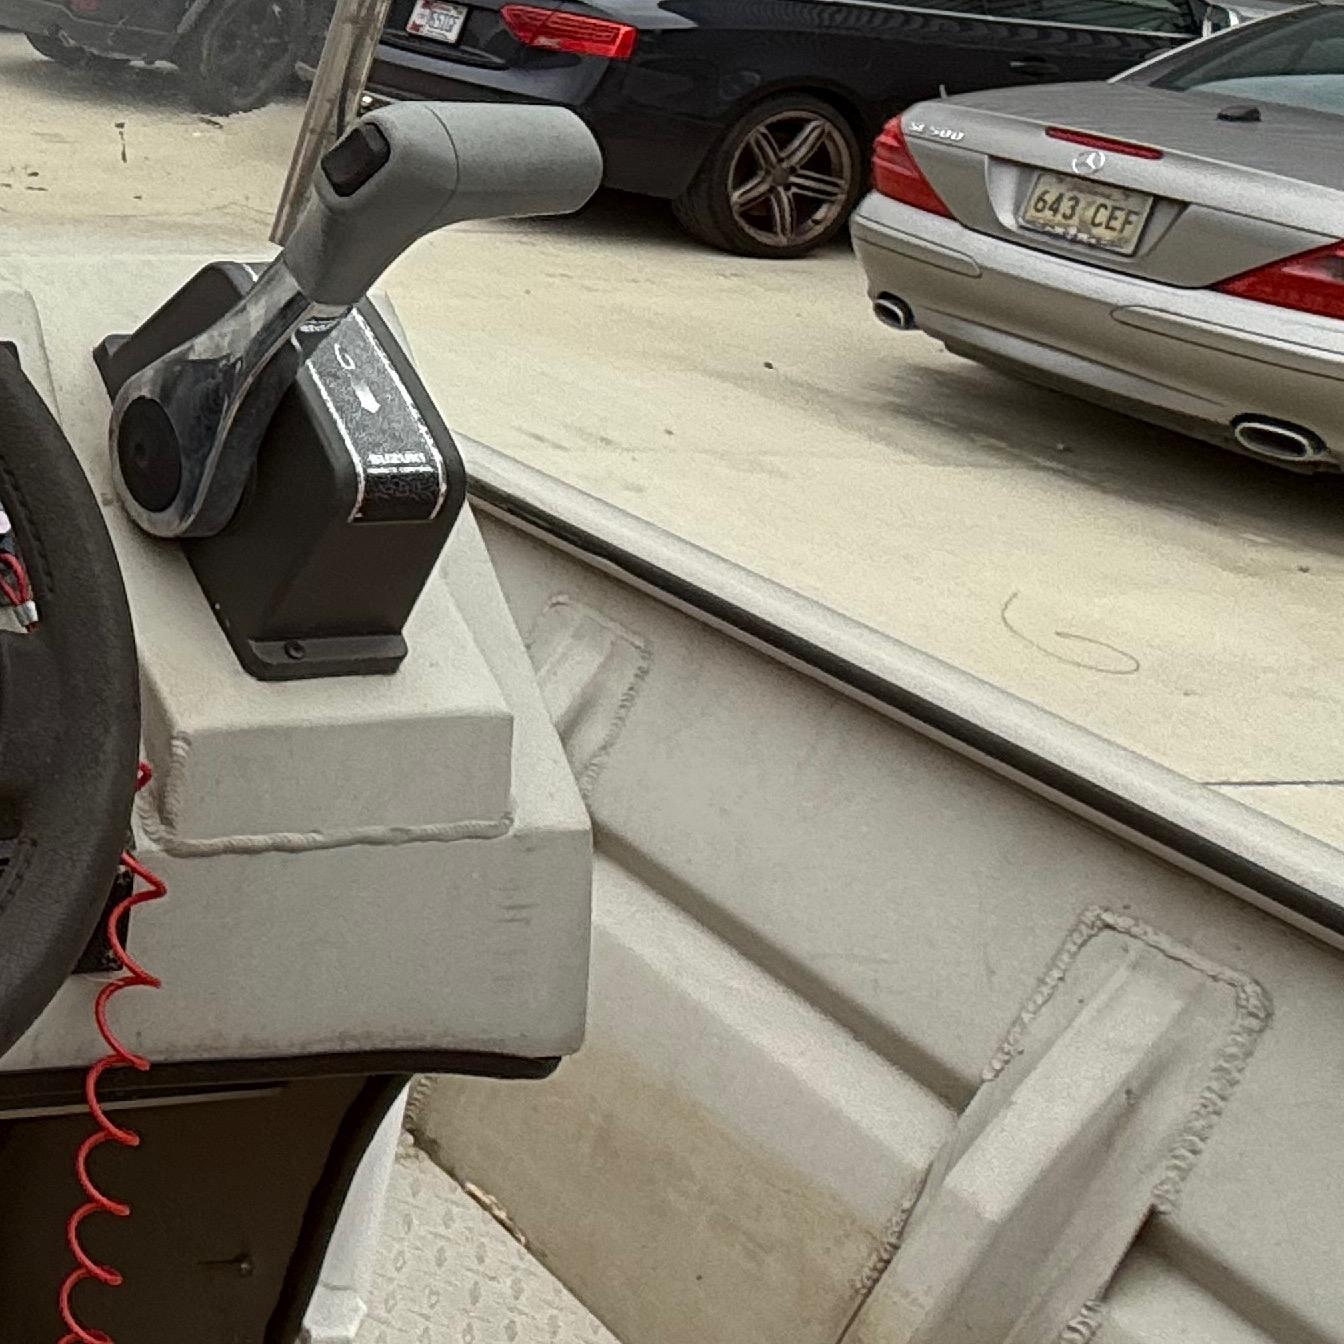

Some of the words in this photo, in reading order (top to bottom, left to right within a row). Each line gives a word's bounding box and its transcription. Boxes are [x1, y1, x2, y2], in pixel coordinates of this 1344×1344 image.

[1032, 188, 1081, 221] 643
[1090, 202, 1141, 234] CEF
[367, 452, 426, 465] SUZUKI
